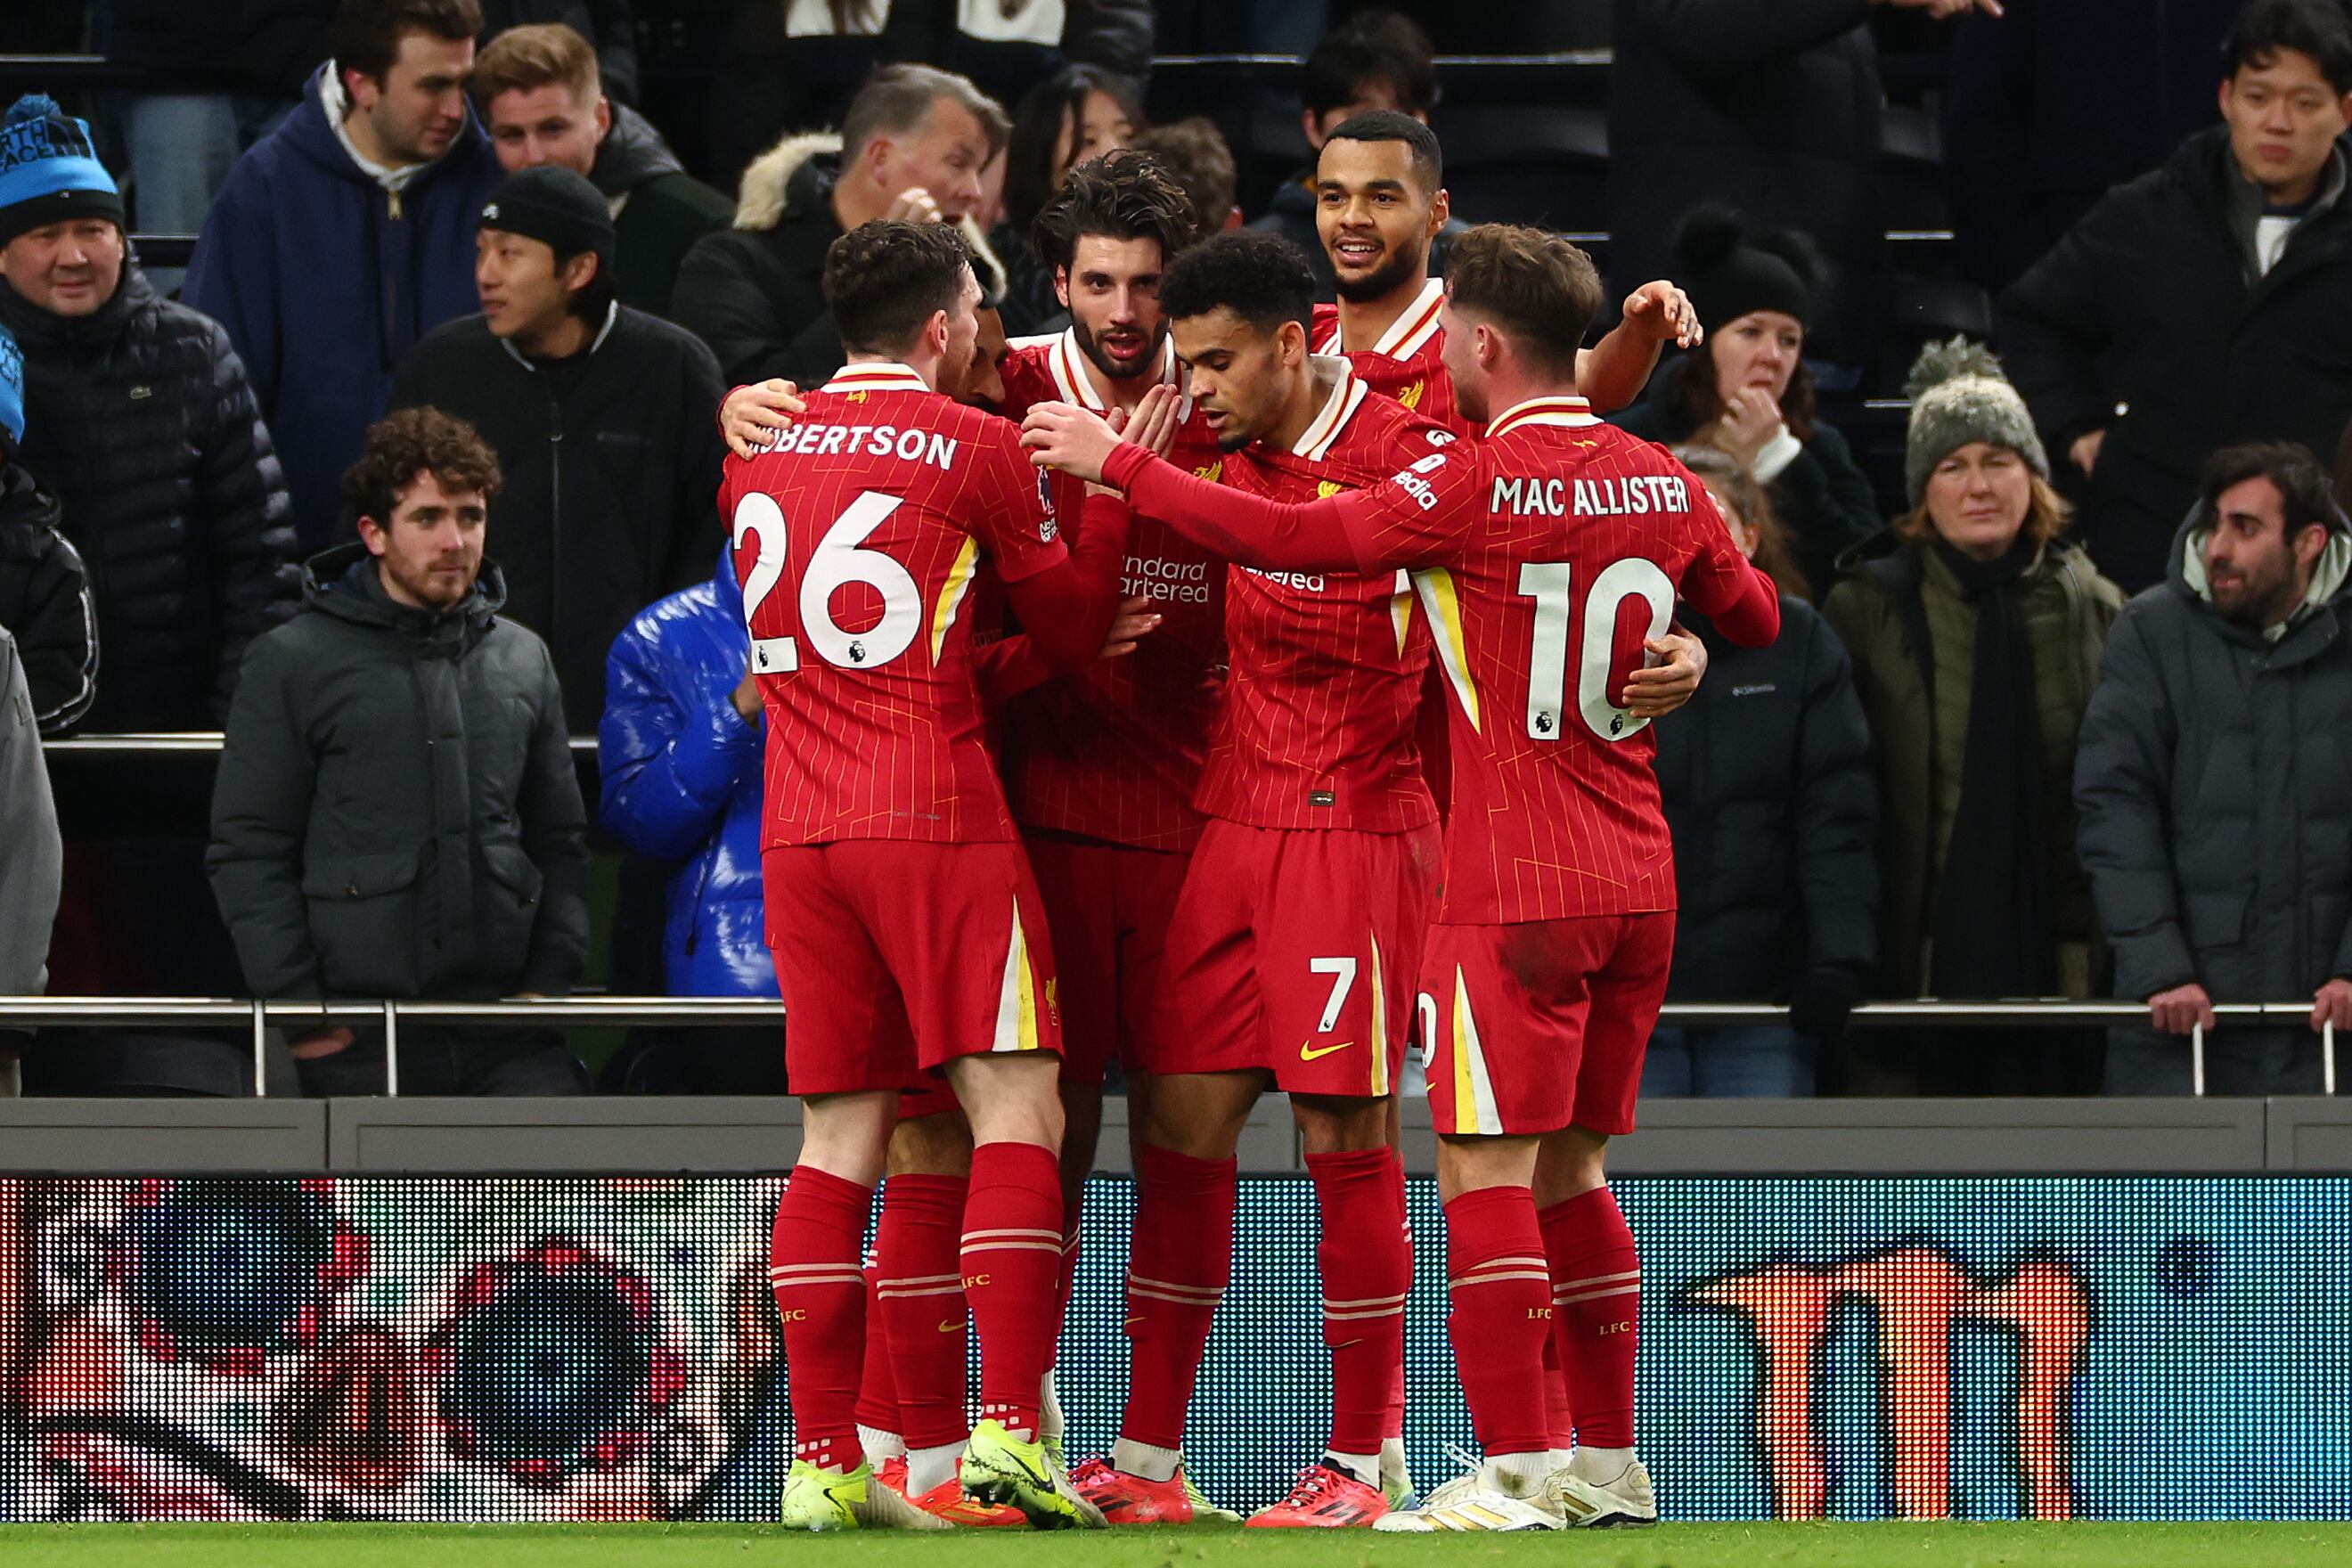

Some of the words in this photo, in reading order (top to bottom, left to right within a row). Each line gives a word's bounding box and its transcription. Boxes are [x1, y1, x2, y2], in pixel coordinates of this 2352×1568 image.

[1491, 476, 1564, 516] MAC
[1573, 475, 1689, 516] ALLISTER
[733, 490, 921, 674] 26
[1123, 555, 1206, 581] ndard
[1517, 558, 1680, 741] 10
[1310, 957, 1357, 1033] 7
[1527, 1308, 1552, 1319] LFC
[1599, 1321, 1630, 1335] LFC
